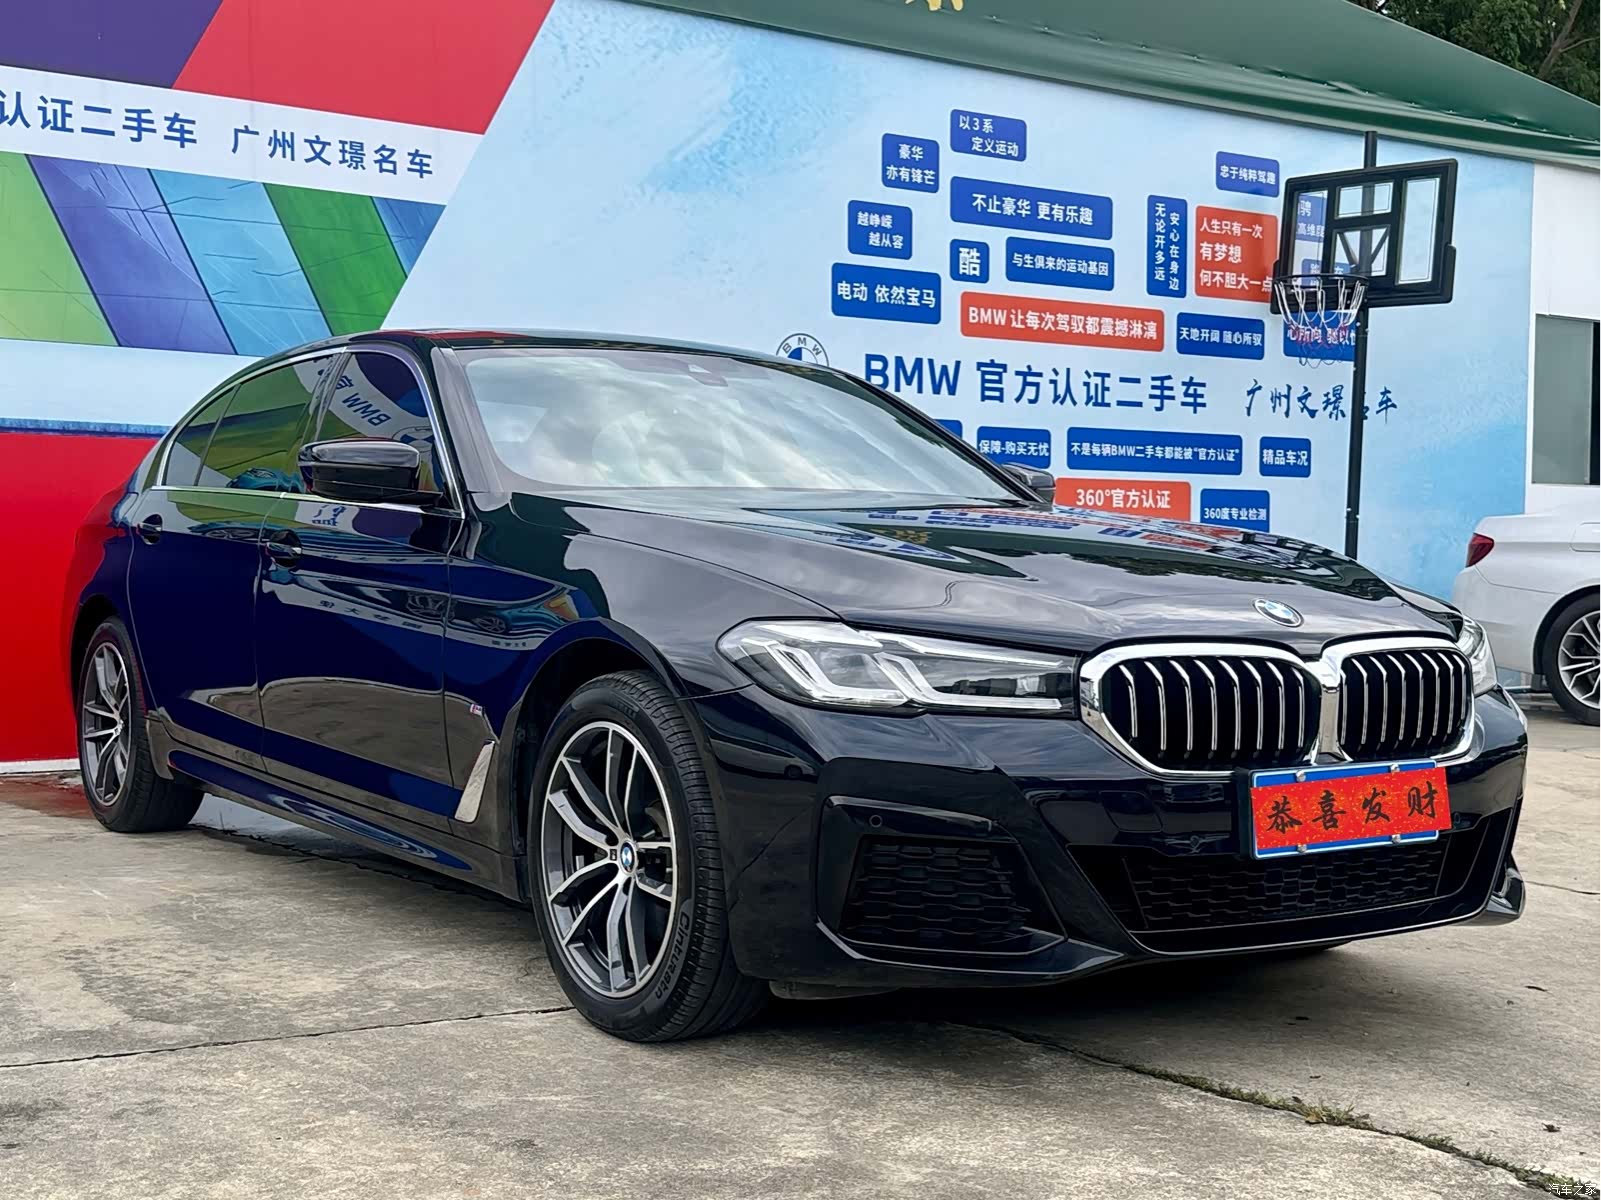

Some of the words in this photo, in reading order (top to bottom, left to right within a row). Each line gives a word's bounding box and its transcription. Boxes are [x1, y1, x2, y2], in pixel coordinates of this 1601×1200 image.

[0, 91, 197, 148] 认证二手车
[231, 125, 433, 178] 广州文璟名车
[898, 144, 924, 161] 豪华
[971, 137, 1019, 157] 定义运动
[886, 165, 935, 185] 亦有锋芒
[1219, 165, 1276, 185] 忠于纯粹驾趣
[857, 211, 893, 229] 越峥嵘
[972, 193, 1031, 218] 不止豪华
[1036, 201, 1094, 225] 更有乐趣
[1199, 217, 1263, 239] 人生只有一次
[868, 231, 904, 249] 越从容
[1154, 203, 1166, 281] 无论开多远
[958, 247, 981, 276] 酷
[1168, 212, 1180, 291] 安心在身边
[1199, 241, 1242, 263] 有梦想
[1012, 252, 1109, 277] 与生俱来的运动基因
[1199, 269, 1273, 293] 何不胆大一点
[837, 280, 868, 301] 电动
[874, 284, 936, 308] 依然宝马
[968, 305, 1007, 326] BMW
[1010, 309, 1158, 340] 让每次驾驭都震撼淋漓
[782, 336, 822, 356] BMW
[1179, 327, 1220, 343] 天地开阔
[1222, 330, 1262, 346] 随心所驭
[864, 353, 961, 396] BMW
[976, 359, 1207, 414] 官方认证二手车
[1246, 379, 1398, 424] 广州文璟车
[979, 440, 1050, 457] 保障-购买无忧
[1262, 449, 1309, 466] 精品车况
[1075, 488, 1172, 509] 360°官方认证
[1203, 507, 1267, 521] 360度专业检测
[1266, 781, 1438, 834] 恭喜发财
